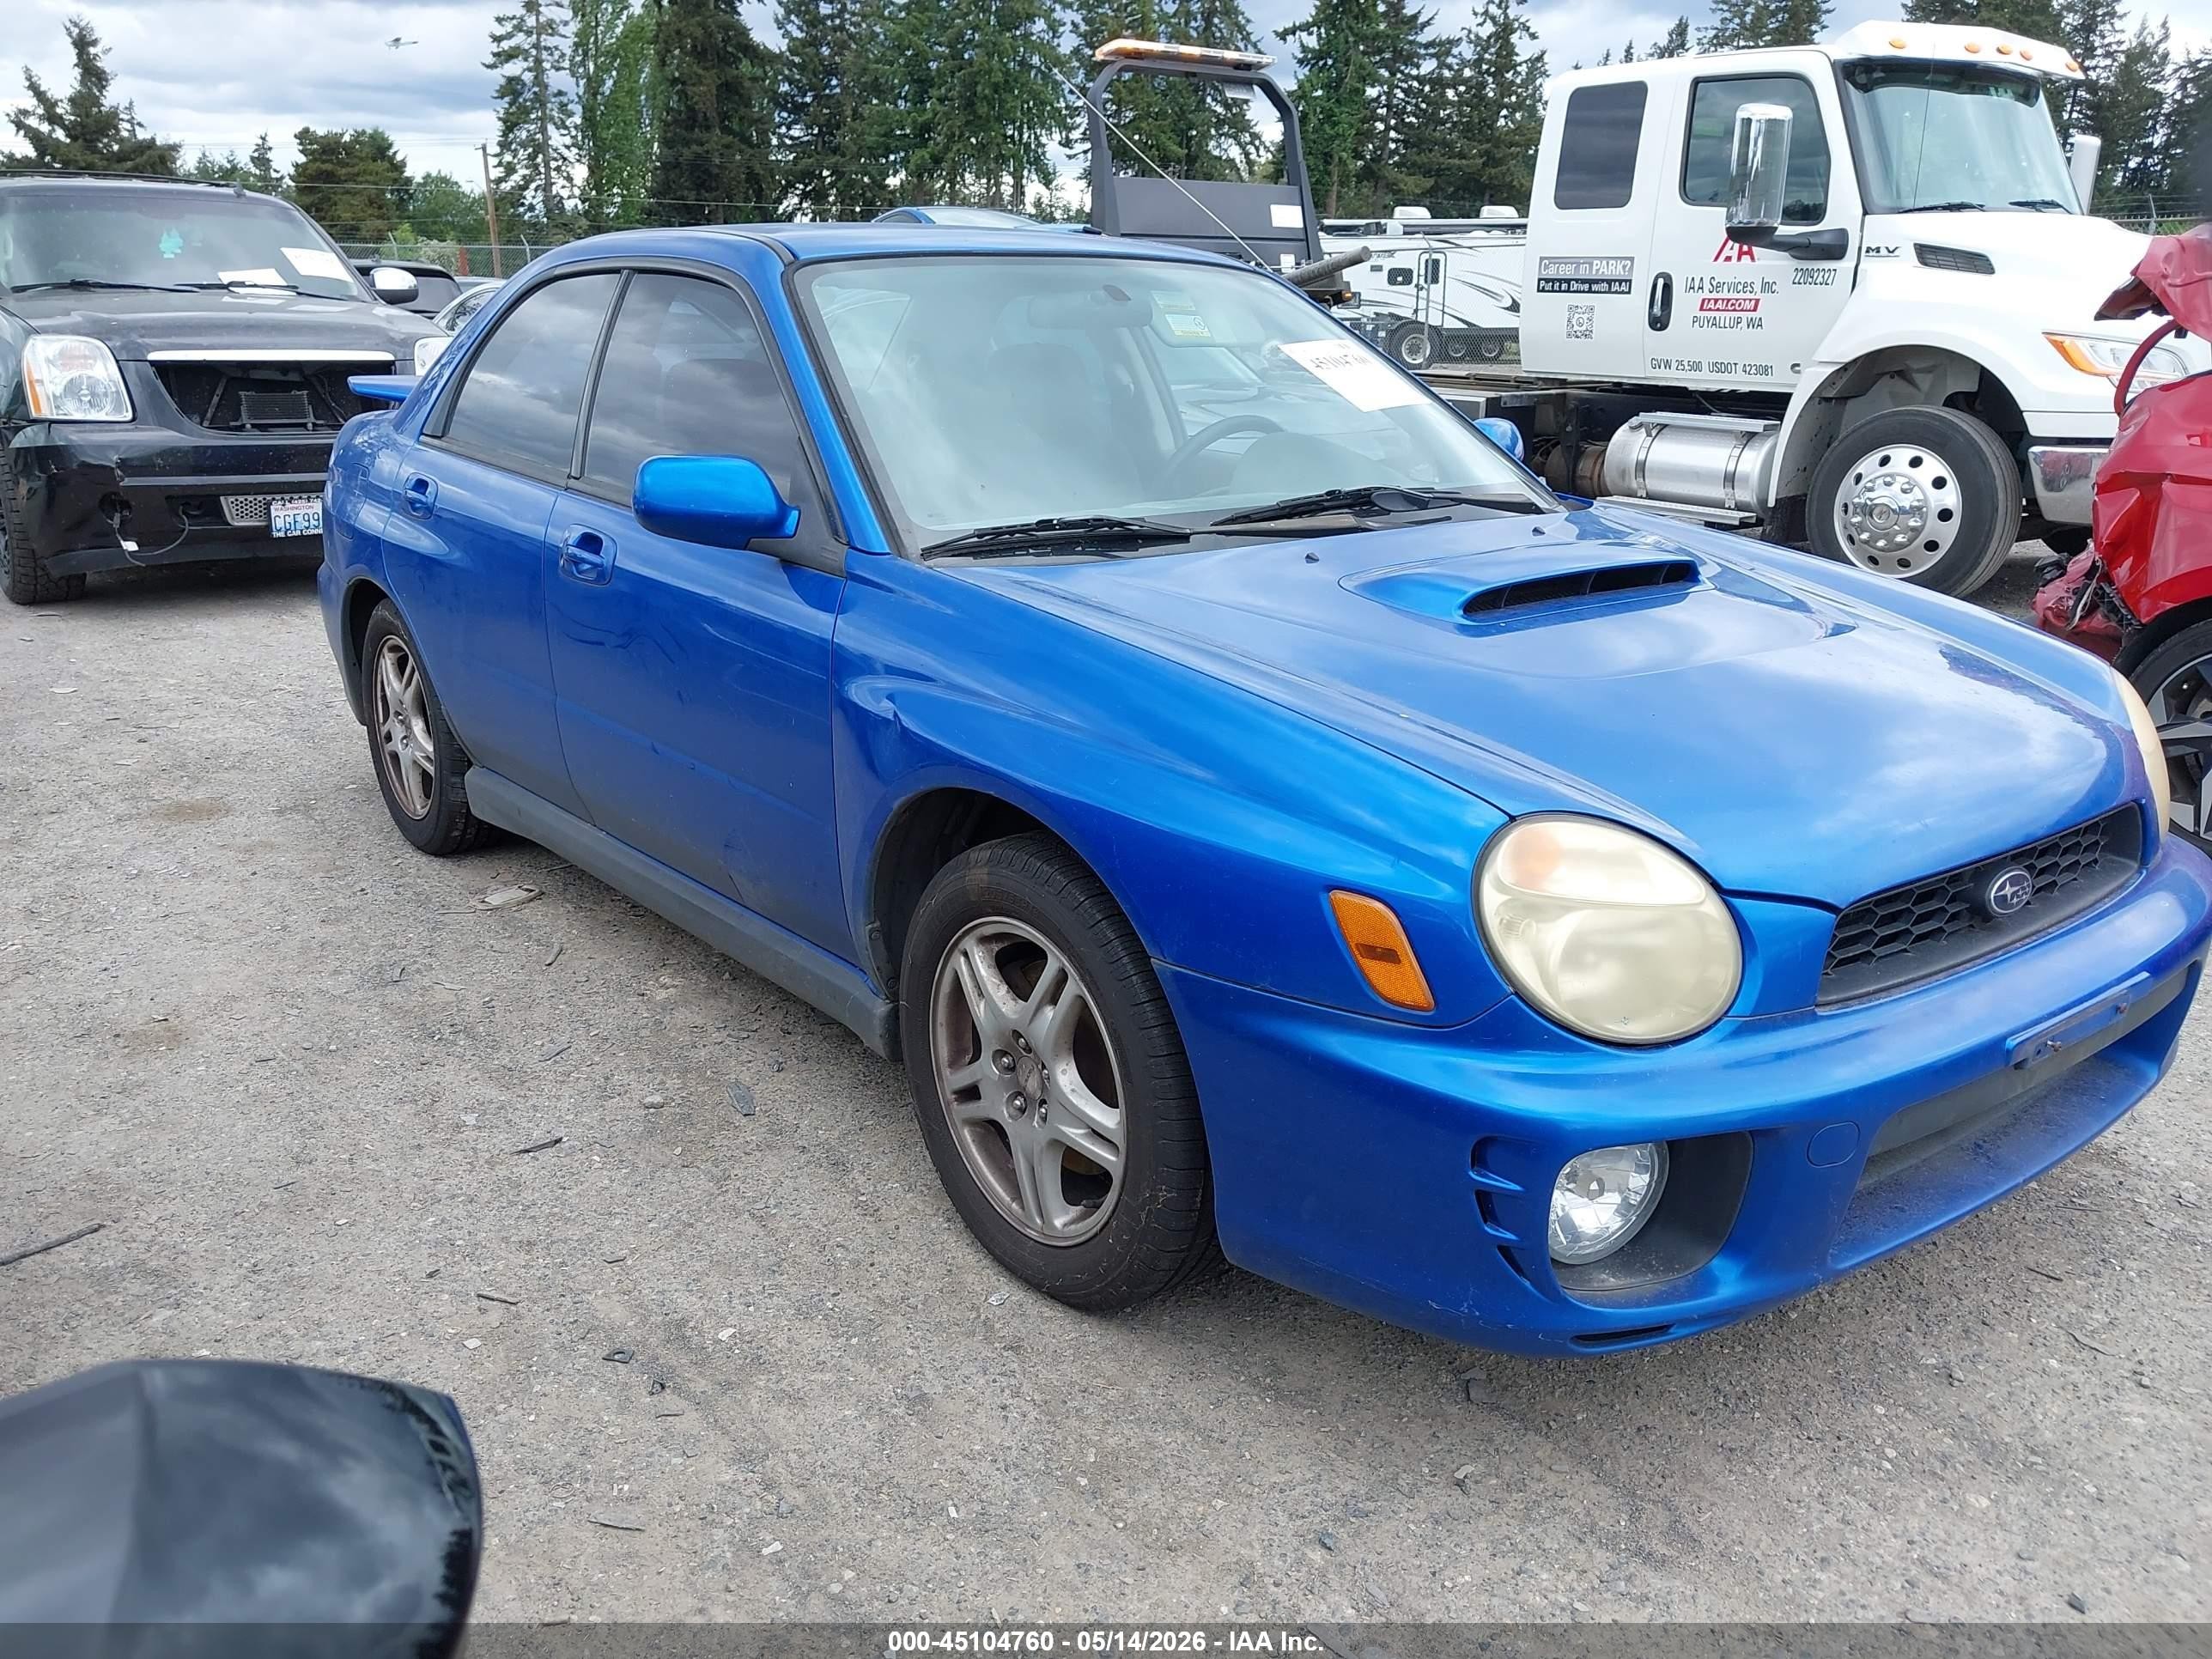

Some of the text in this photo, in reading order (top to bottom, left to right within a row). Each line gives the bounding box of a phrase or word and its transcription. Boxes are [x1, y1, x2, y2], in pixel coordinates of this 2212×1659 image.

[1540, 259, 1632, 276] Career in PARK?
[1792, 267, 1838, 286] 22092327
[1539, 280, 1630, 292] Put it in Drive with IAAI
[1685, 276, 1779, 295] IAA Services, Inc.
[1703, 300, 1755, 311] IAAI.COM
[1692, 315, 1764, 331] PUYALLUP, WA
[1650, 357, 1774, 376] GVW 25,500 USDOT 423081
